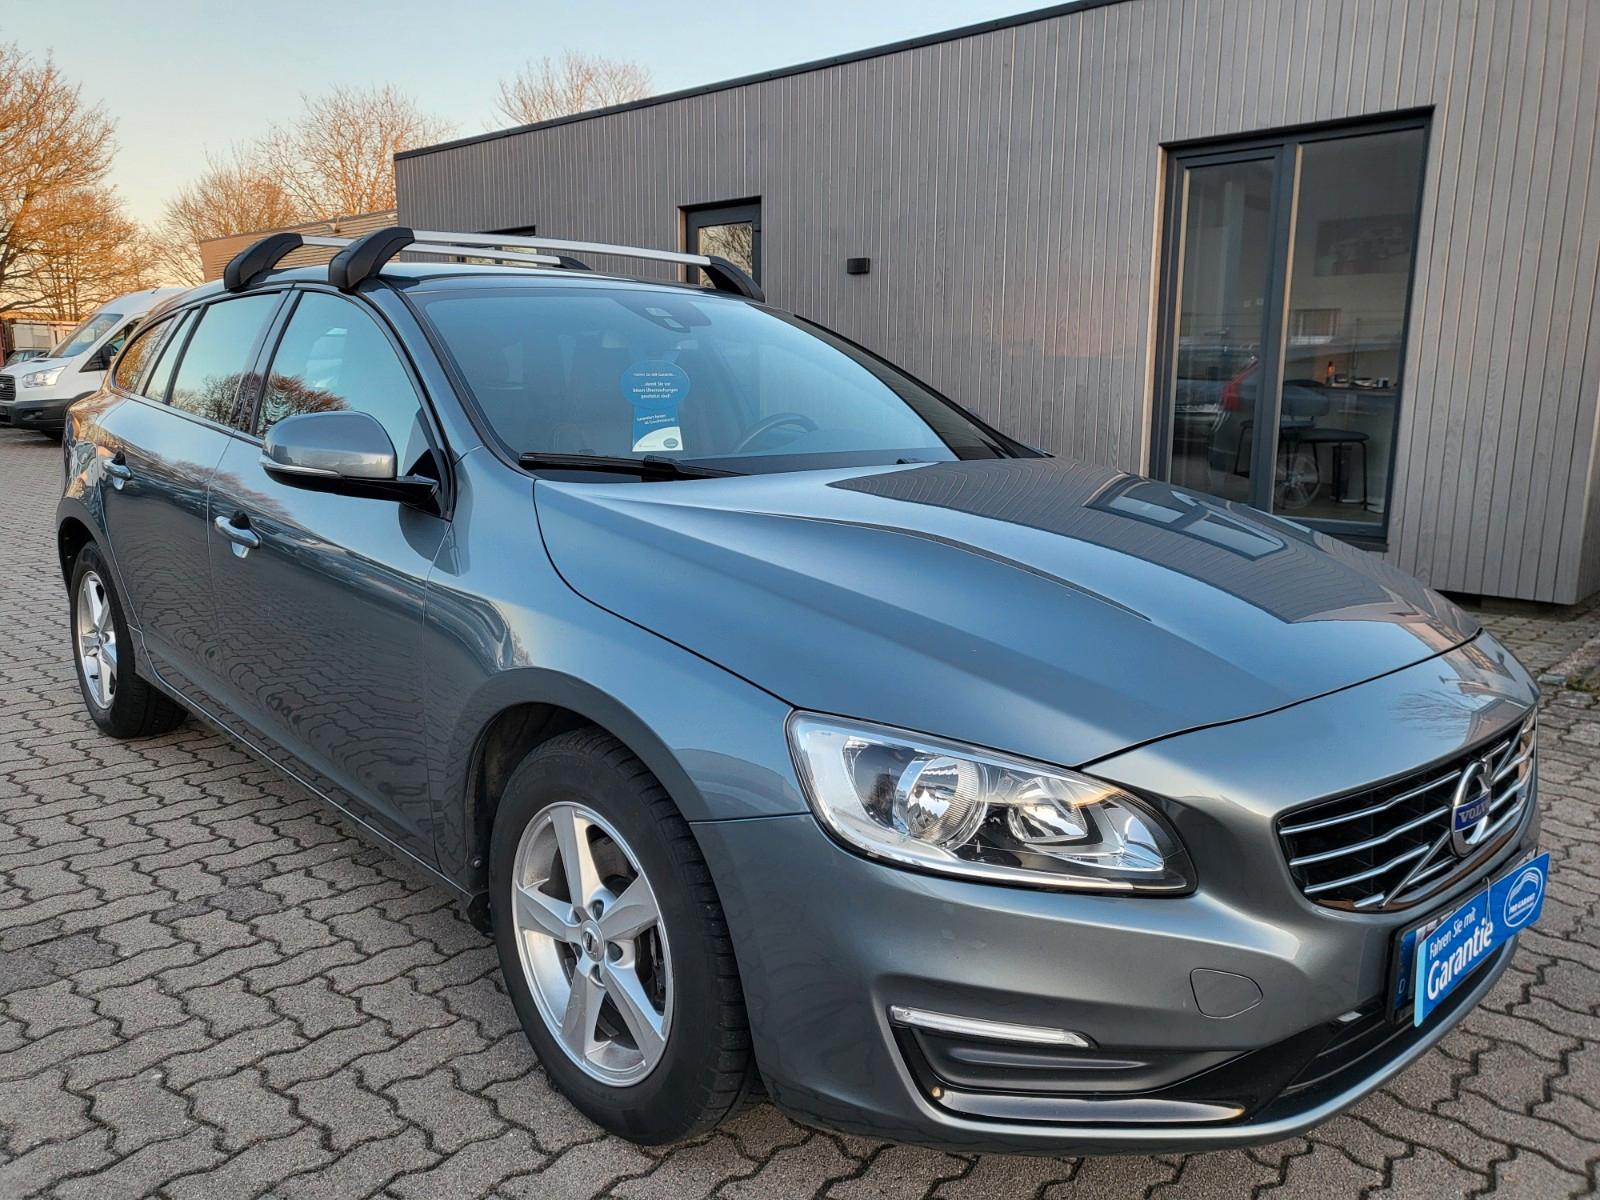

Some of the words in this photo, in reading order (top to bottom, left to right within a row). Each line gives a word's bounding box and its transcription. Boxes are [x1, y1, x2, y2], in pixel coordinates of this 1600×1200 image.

[1427, 917, 1494, 1000] Garantie
[1429, 926, 1452, 961] Fahren
[1452, 917, 1463, 938] Sie
[1463, 907, 1476, 929] mit
